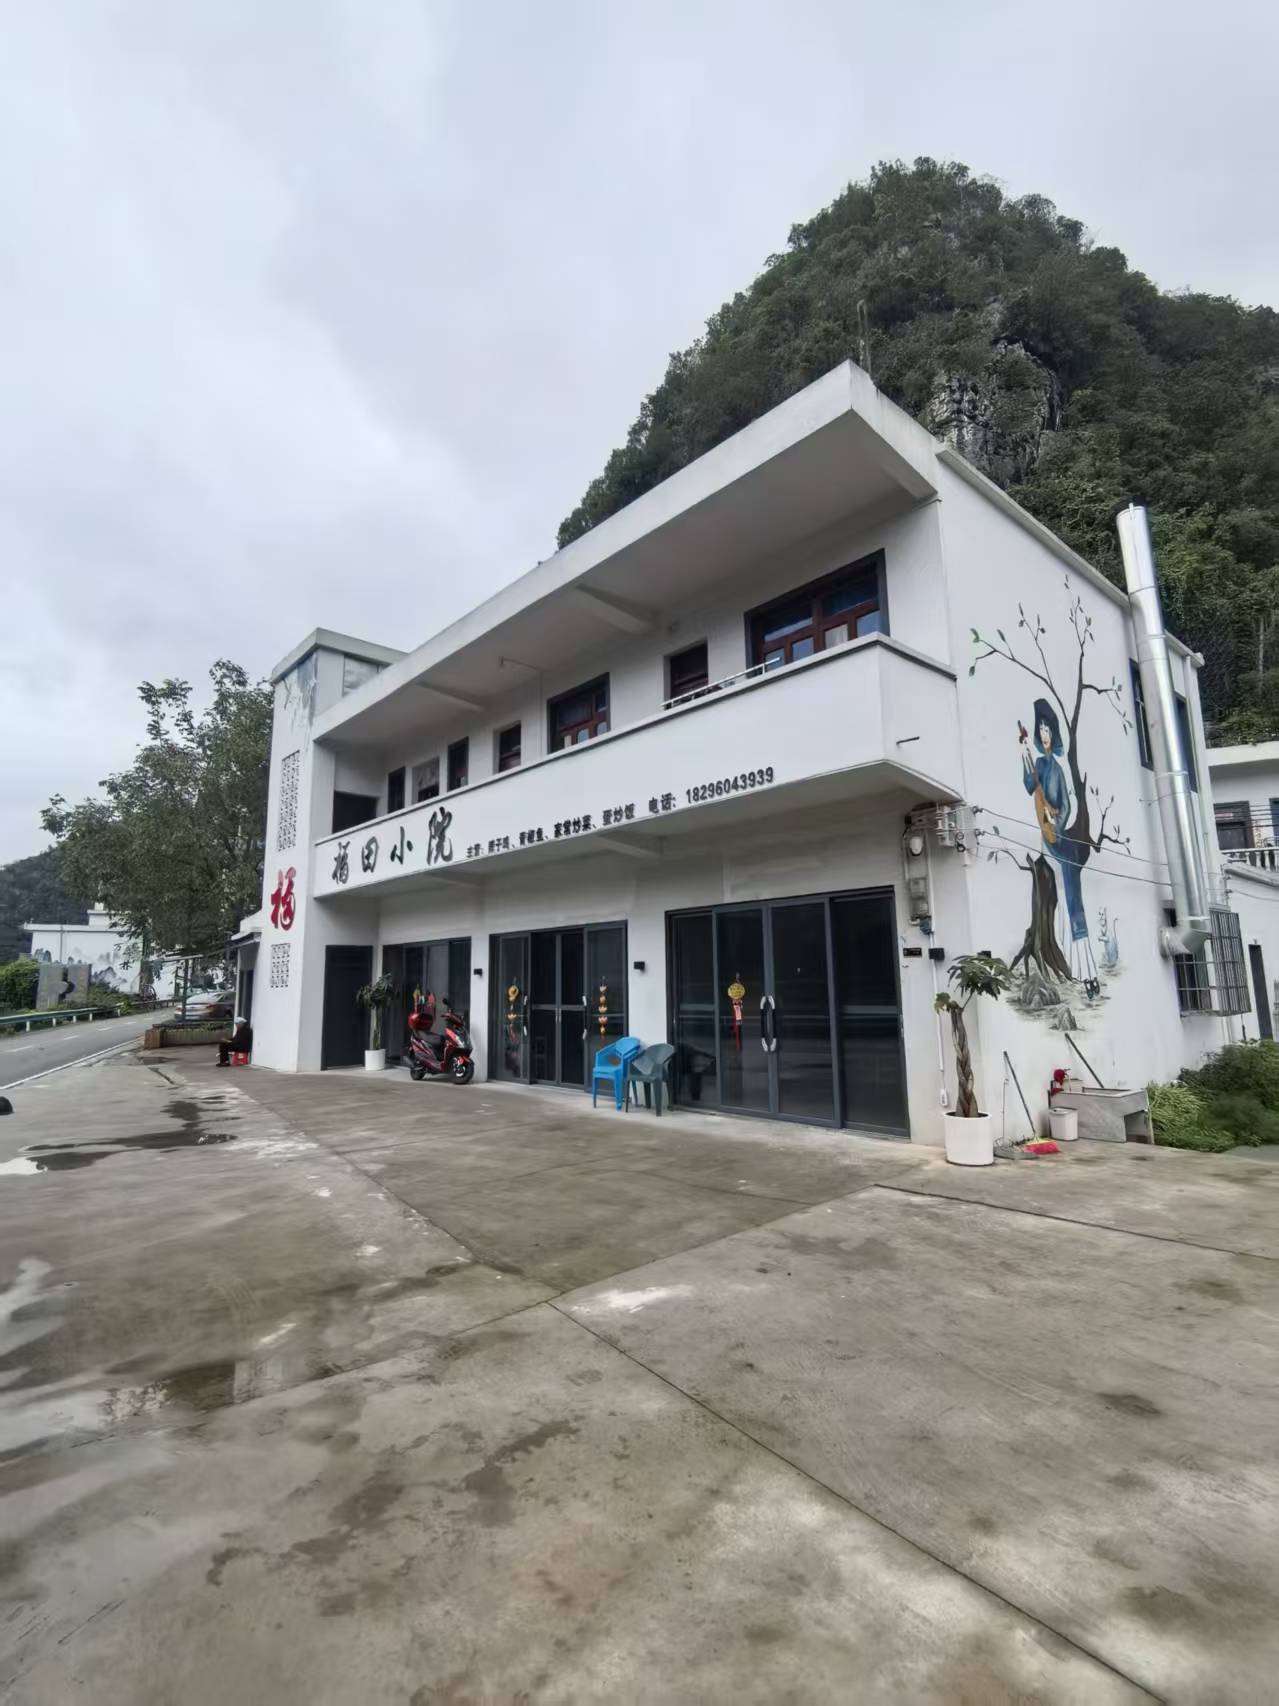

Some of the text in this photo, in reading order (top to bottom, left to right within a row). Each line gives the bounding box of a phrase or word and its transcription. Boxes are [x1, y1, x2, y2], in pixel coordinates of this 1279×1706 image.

[686, 766, 774, 803] 18296043939
[331, 806, 453, 885] 福田小院
[270, 866, 297, 931] 福
